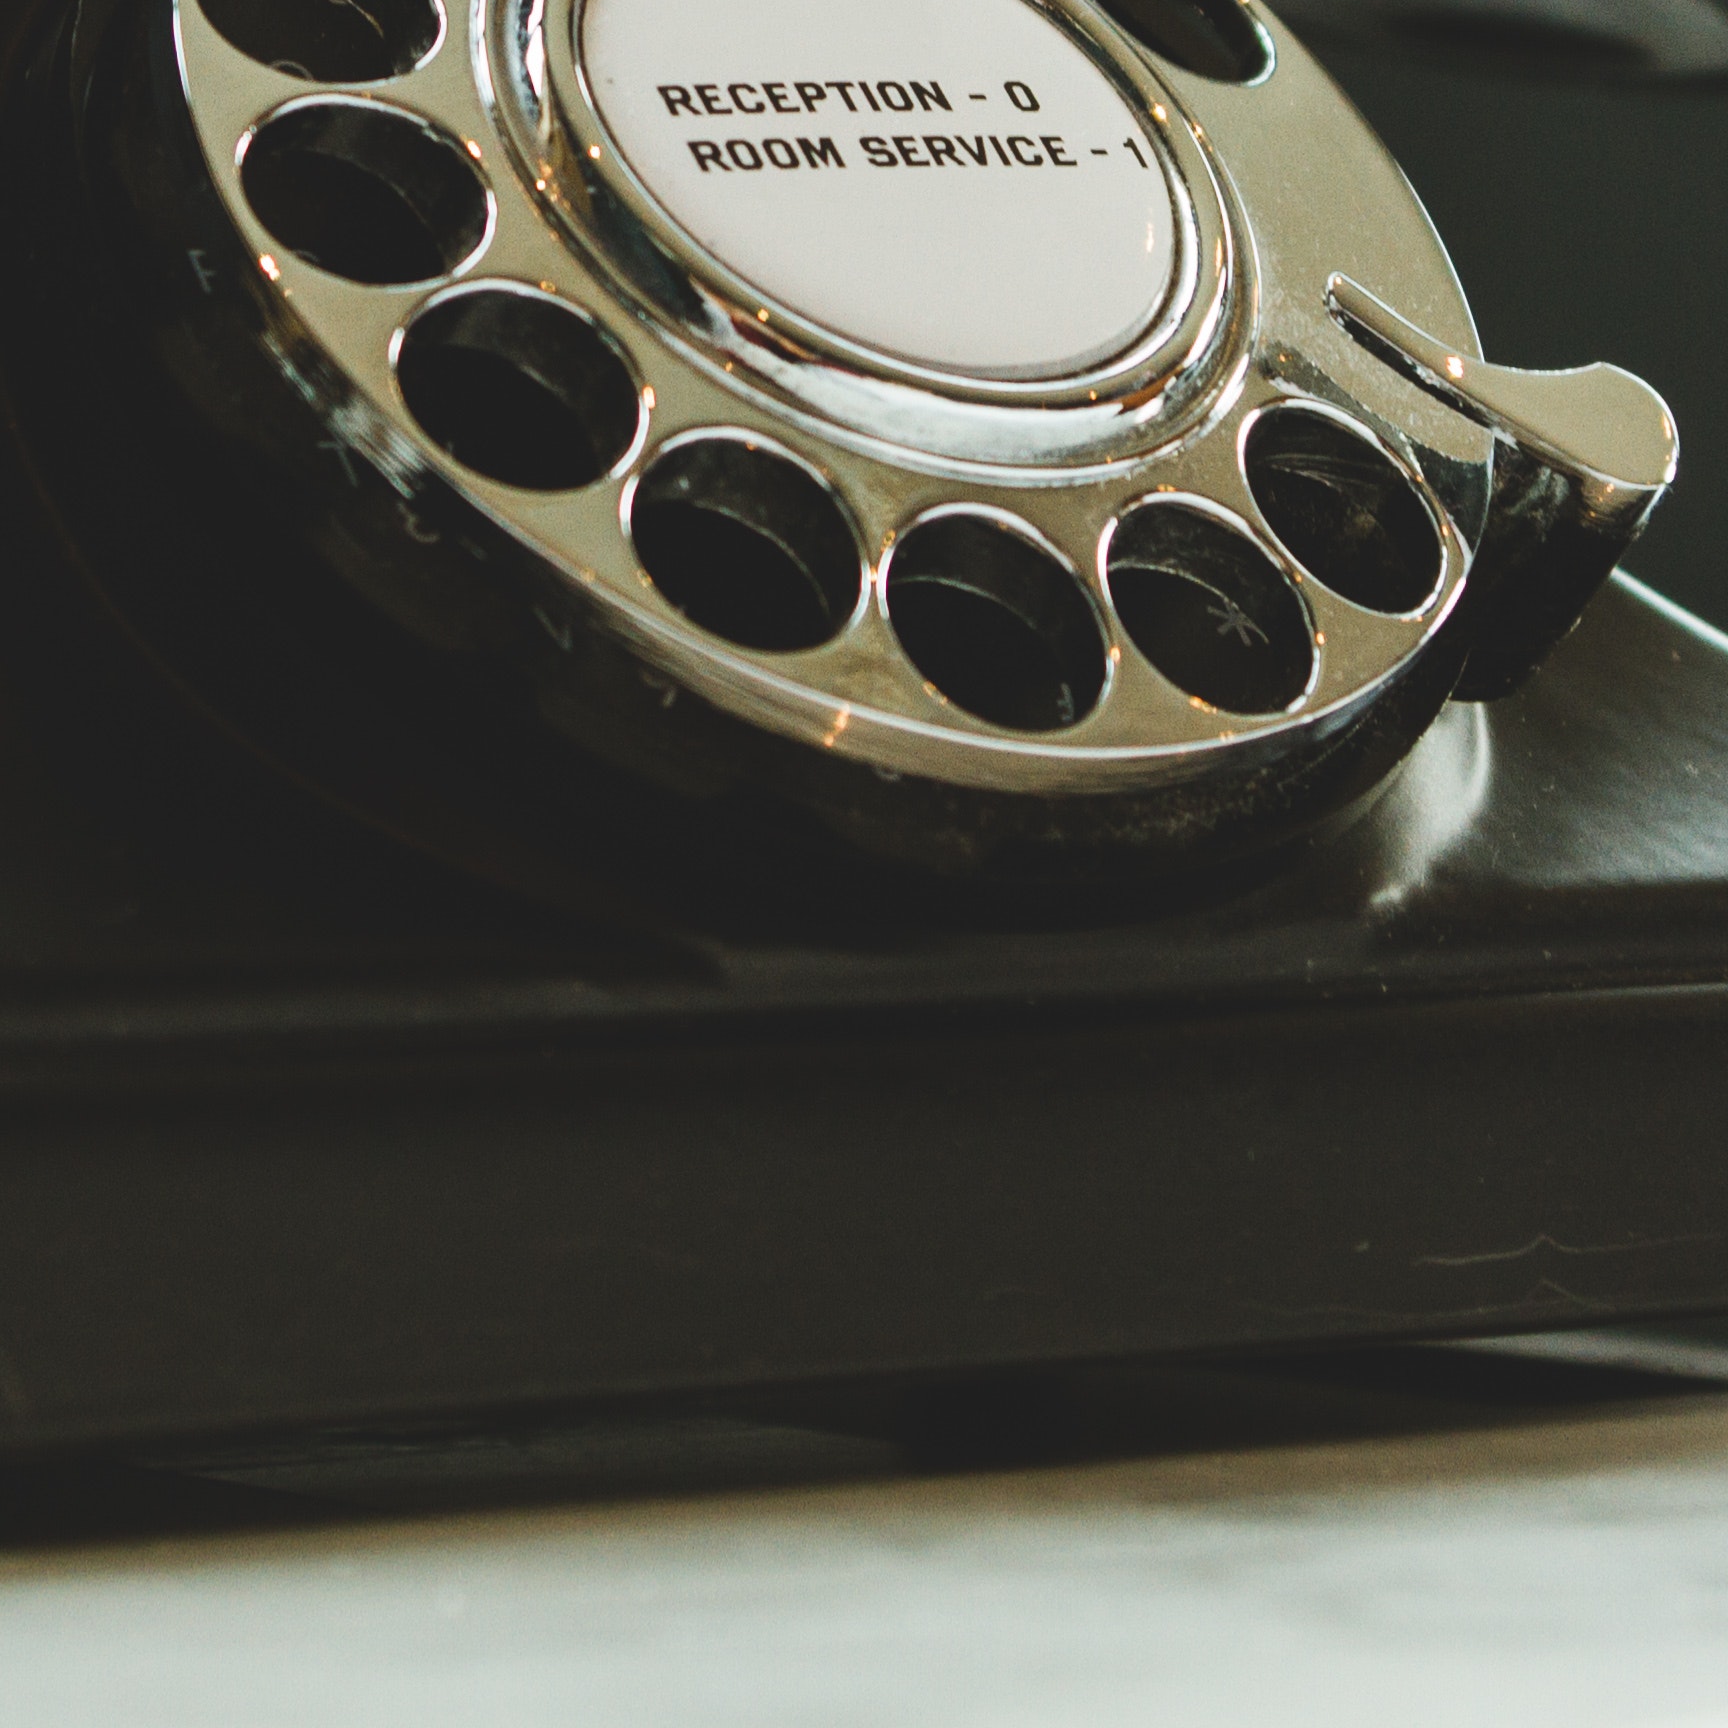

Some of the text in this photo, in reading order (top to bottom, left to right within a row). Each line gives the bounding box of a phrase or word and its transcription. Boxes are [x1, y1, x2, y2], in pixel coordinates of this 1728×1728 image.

[657, 81, 953, 116] RECEPTION
[687, 136, 846, 172] ROOM
[859, 135, 1078, 167] SERVICE
[1123, 138, 1149, 168] 1
